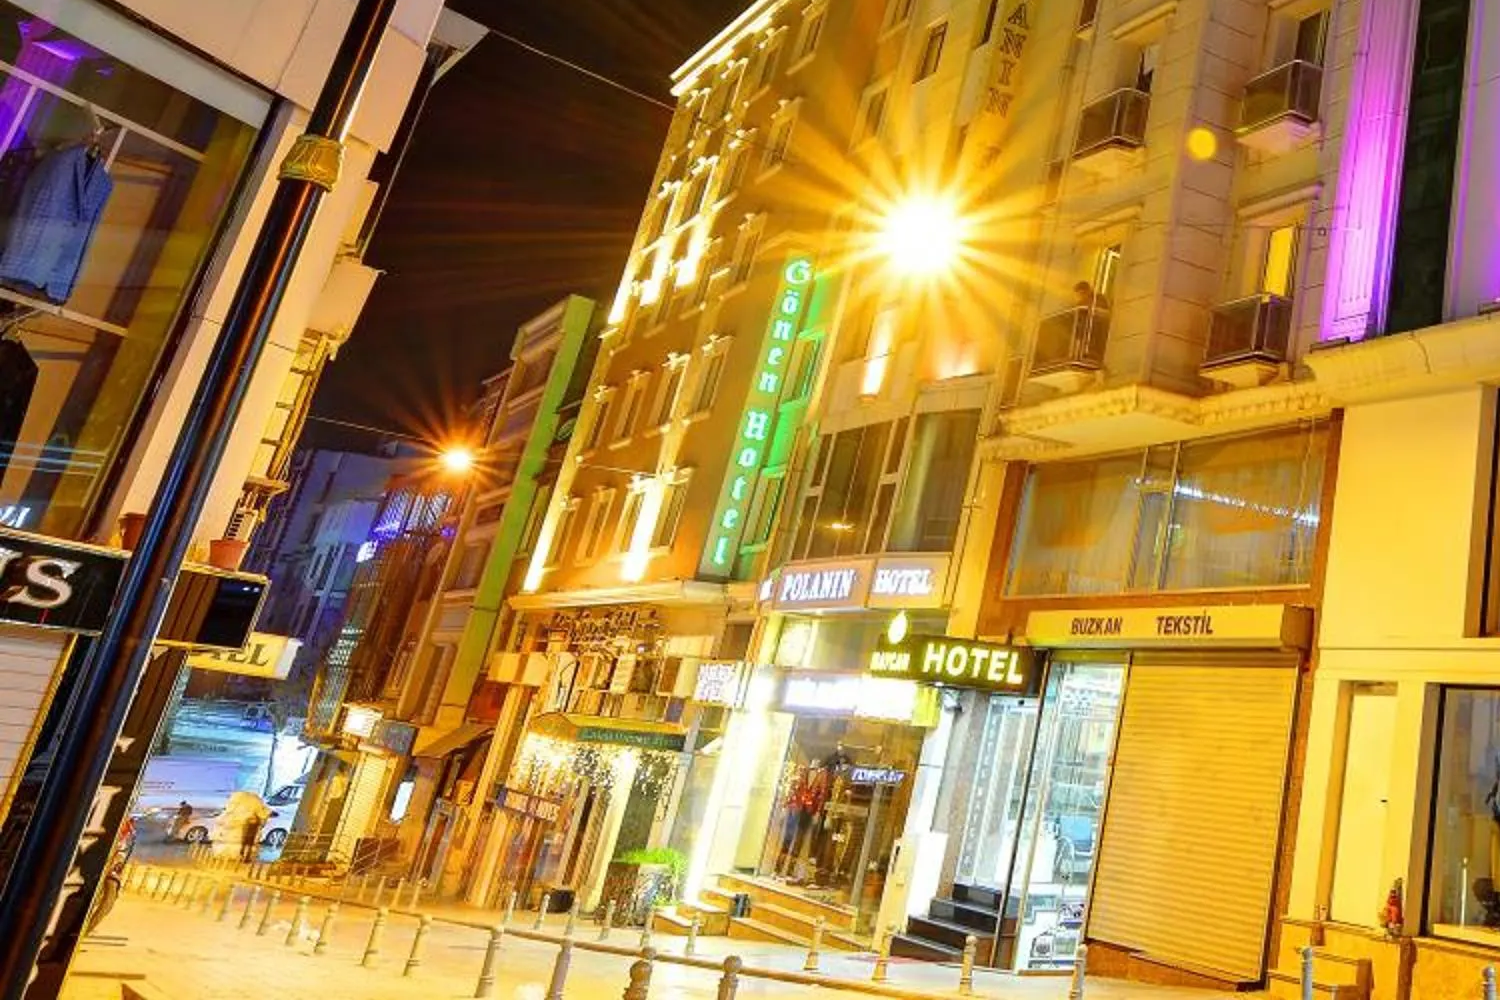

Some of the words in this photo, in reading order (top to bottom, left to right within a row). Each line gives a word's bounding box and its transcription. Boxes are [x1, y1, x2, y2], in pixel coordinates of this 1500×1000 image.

[756, 259, 813, 393] Gönen
[713, 410, 769, 565] Hotel
[779, 568, 855, 602] POLANIN
[872, 568, 932, 595] HOTEL
[1071, 617, 1123, 635] BUZKAN
[1156, 610, 1214, 634] TEKSTİL
[923, 643, 1023, 685] HOTEL
